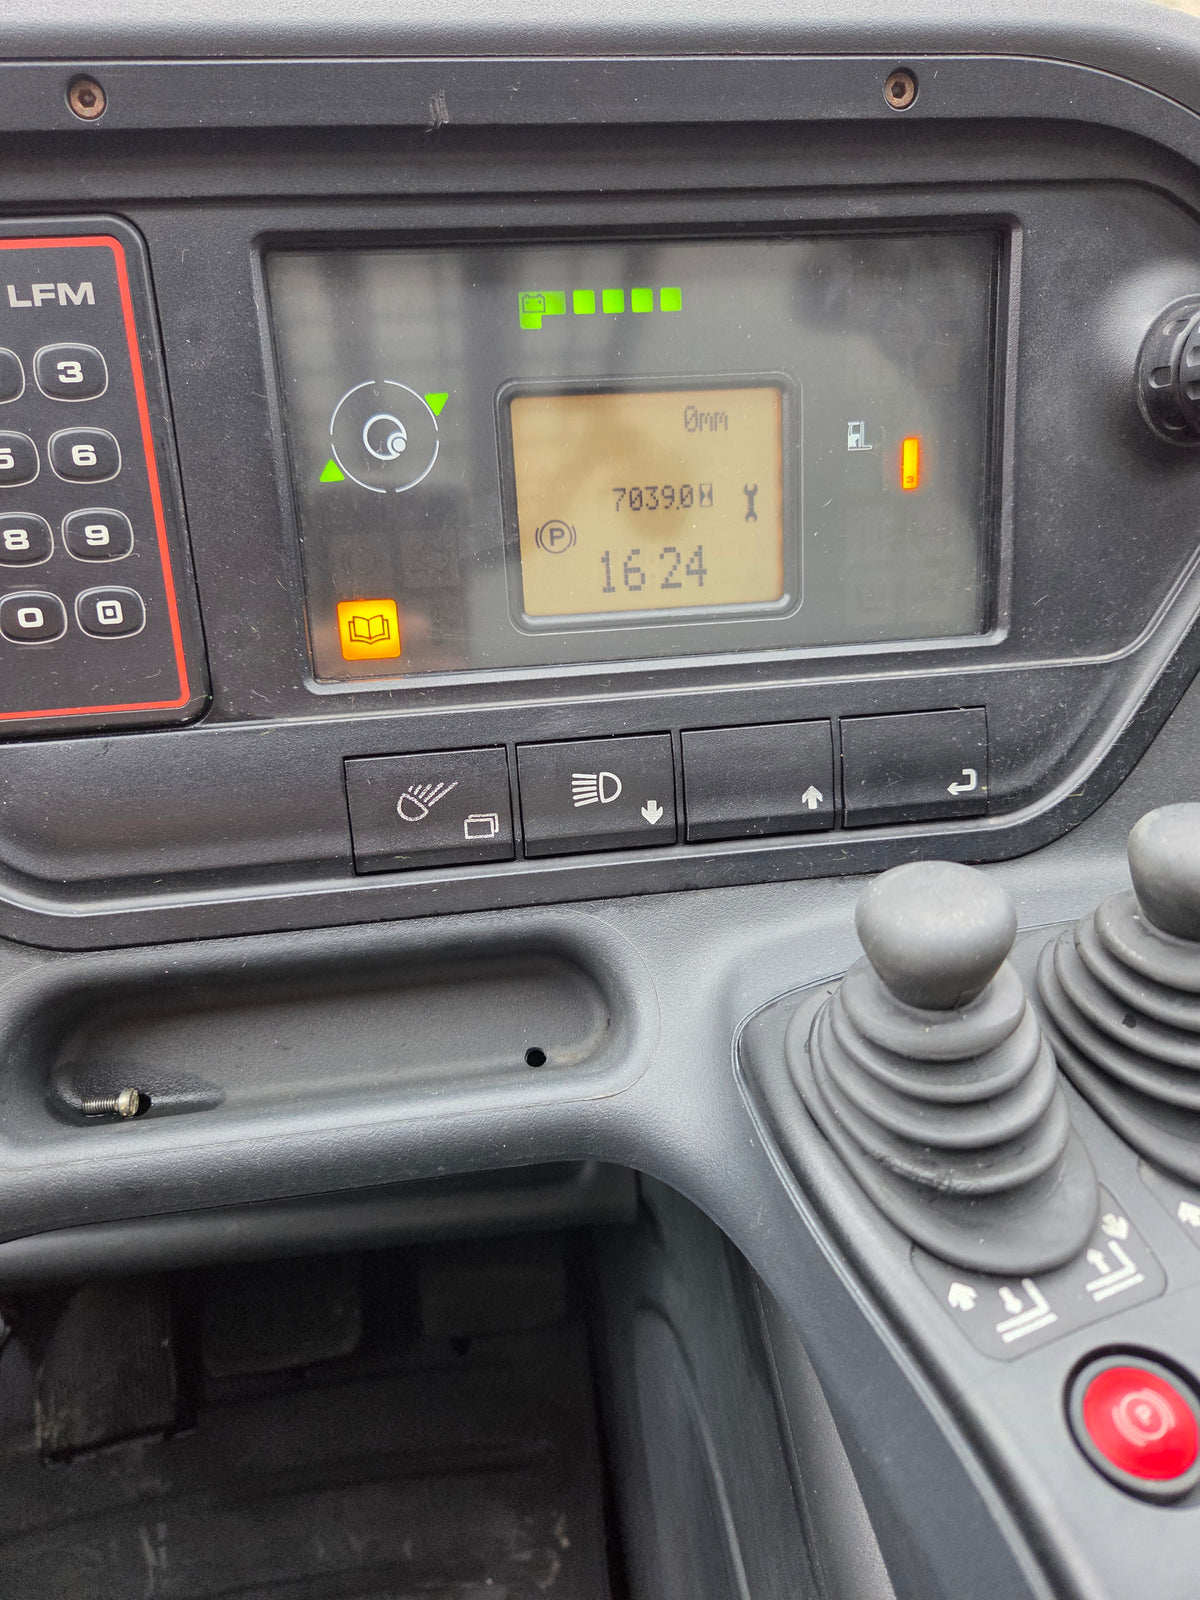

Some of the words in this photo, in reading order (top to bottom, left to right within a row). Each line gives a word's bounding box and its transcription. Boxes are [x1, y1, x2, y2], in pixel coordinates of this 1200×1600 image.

[7, 282, 96, 308] LFM
[56, 361, 84, 384] 3
[684, 405, 728, 432] 0mm
[71, 444, 97, 467] 6
[613, 484, 694, 512] 7039.0
[3, 529, 30, 550] 8
[84, 524, 110, 546] 9
